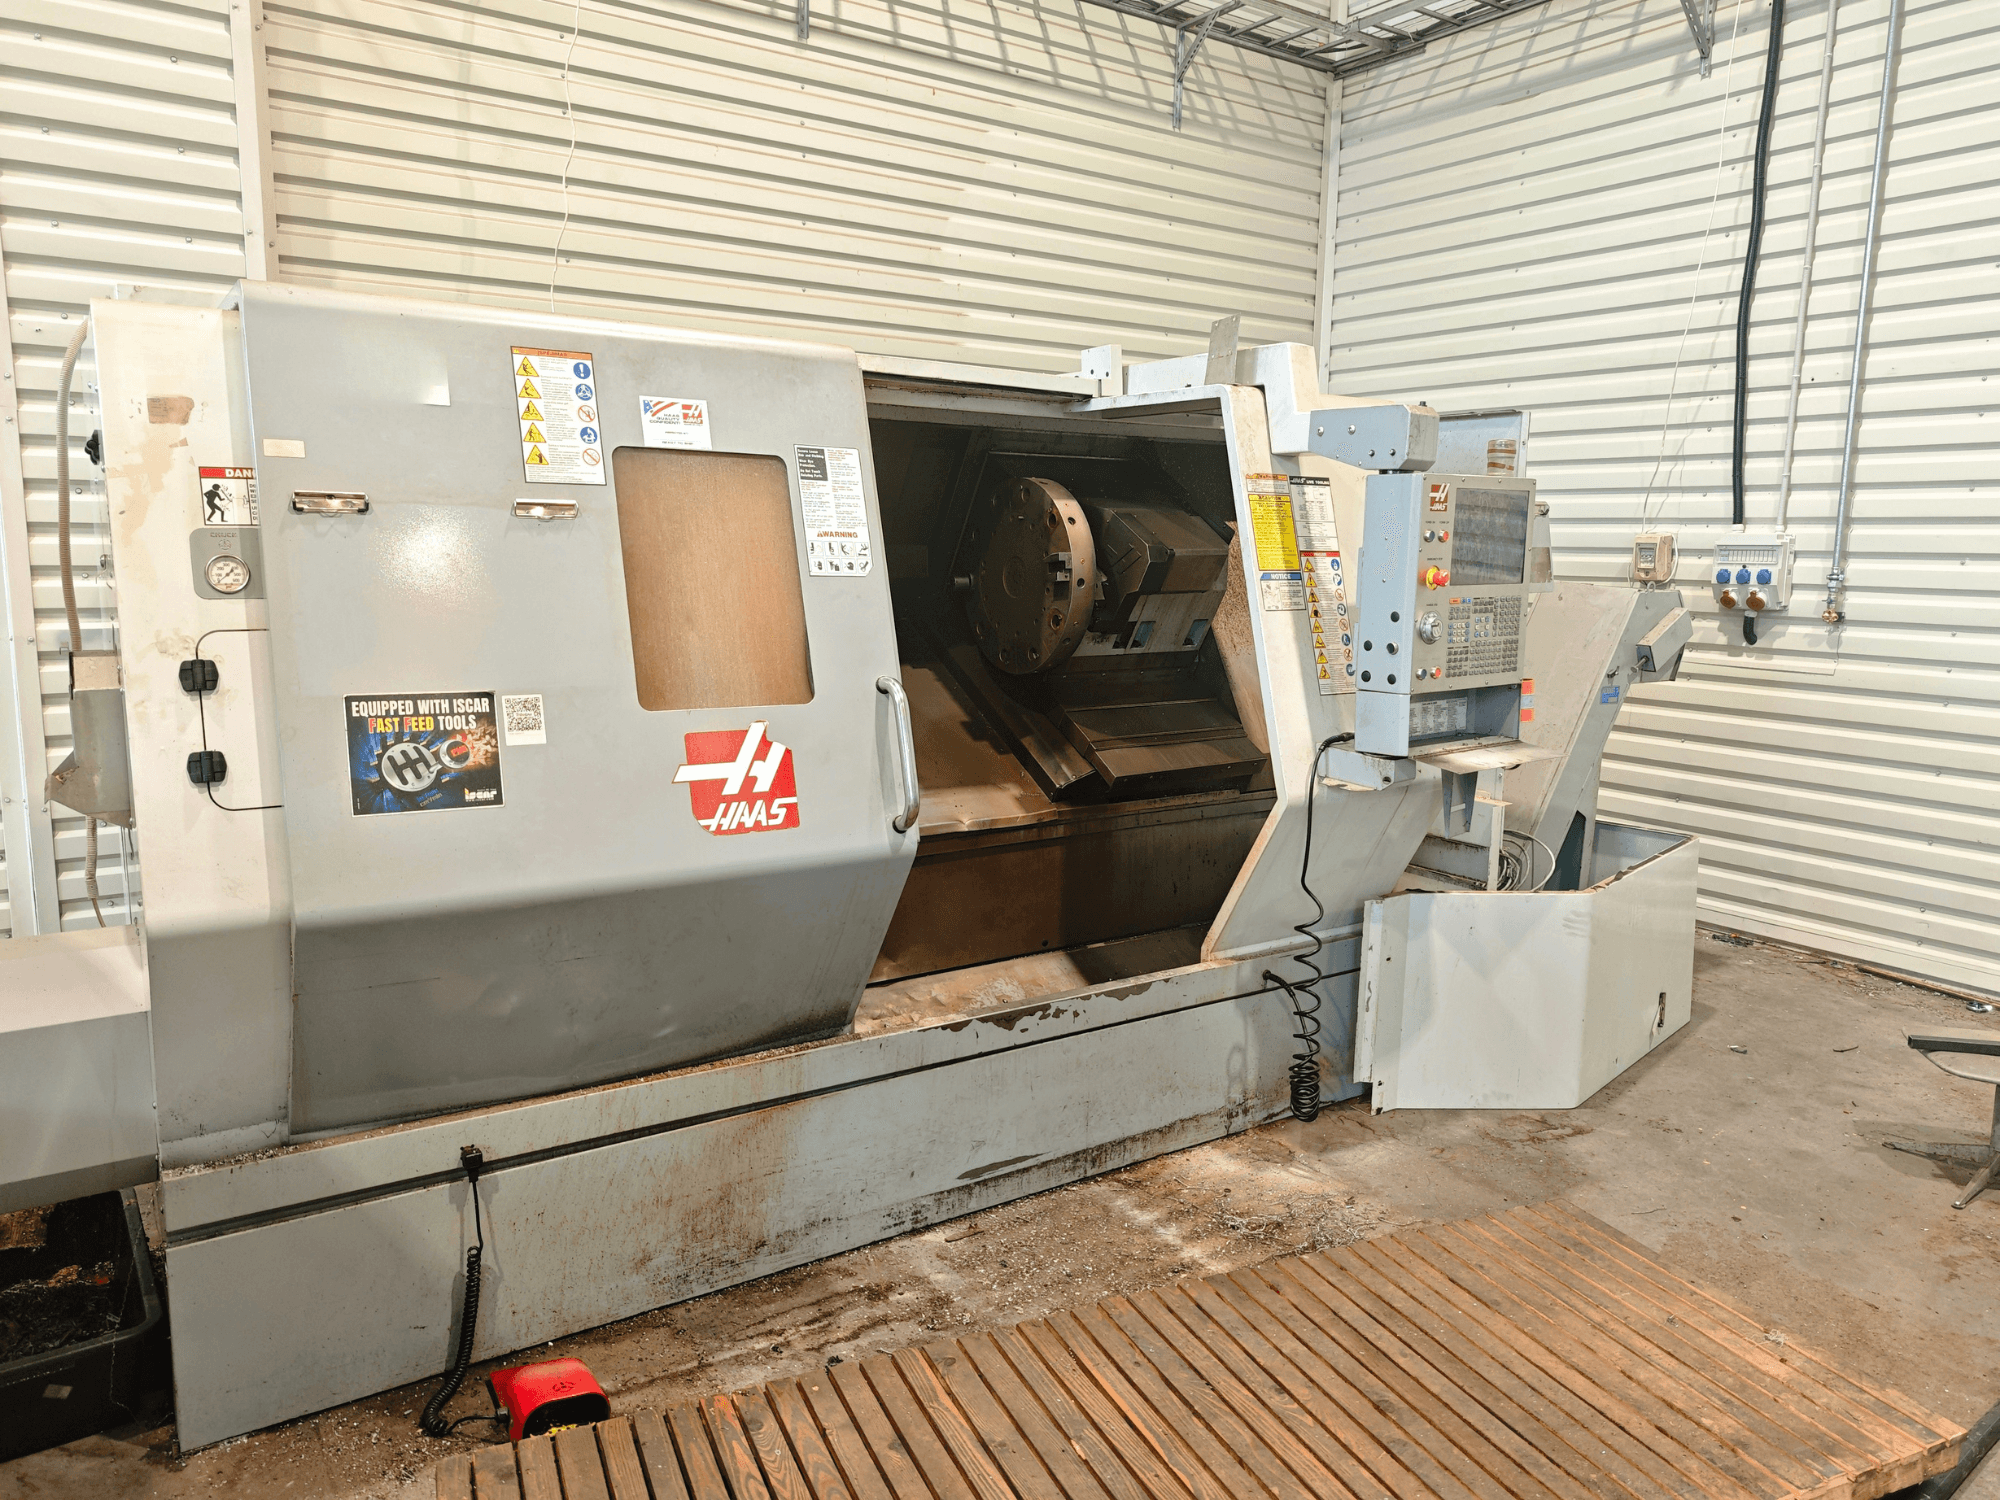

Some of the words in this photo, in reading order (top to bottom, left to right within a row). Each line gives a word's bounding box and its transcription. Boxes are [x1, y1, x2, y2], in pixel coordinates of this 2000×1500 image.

[225, 468, 256, 478] DAN
[822, 530, 858, 538] WARNING
[351, 700, 414, 717] EQUIPPED
[417, 698, 450, 714] WITH
[453, 697, 490, 713] ISCAR
[368, 717, 399, 734] FAST
[403, 716, 435, 733] FEED
[437, 714, 477, 730] TOOLS
[698, 796, 798, 832] HAAS
